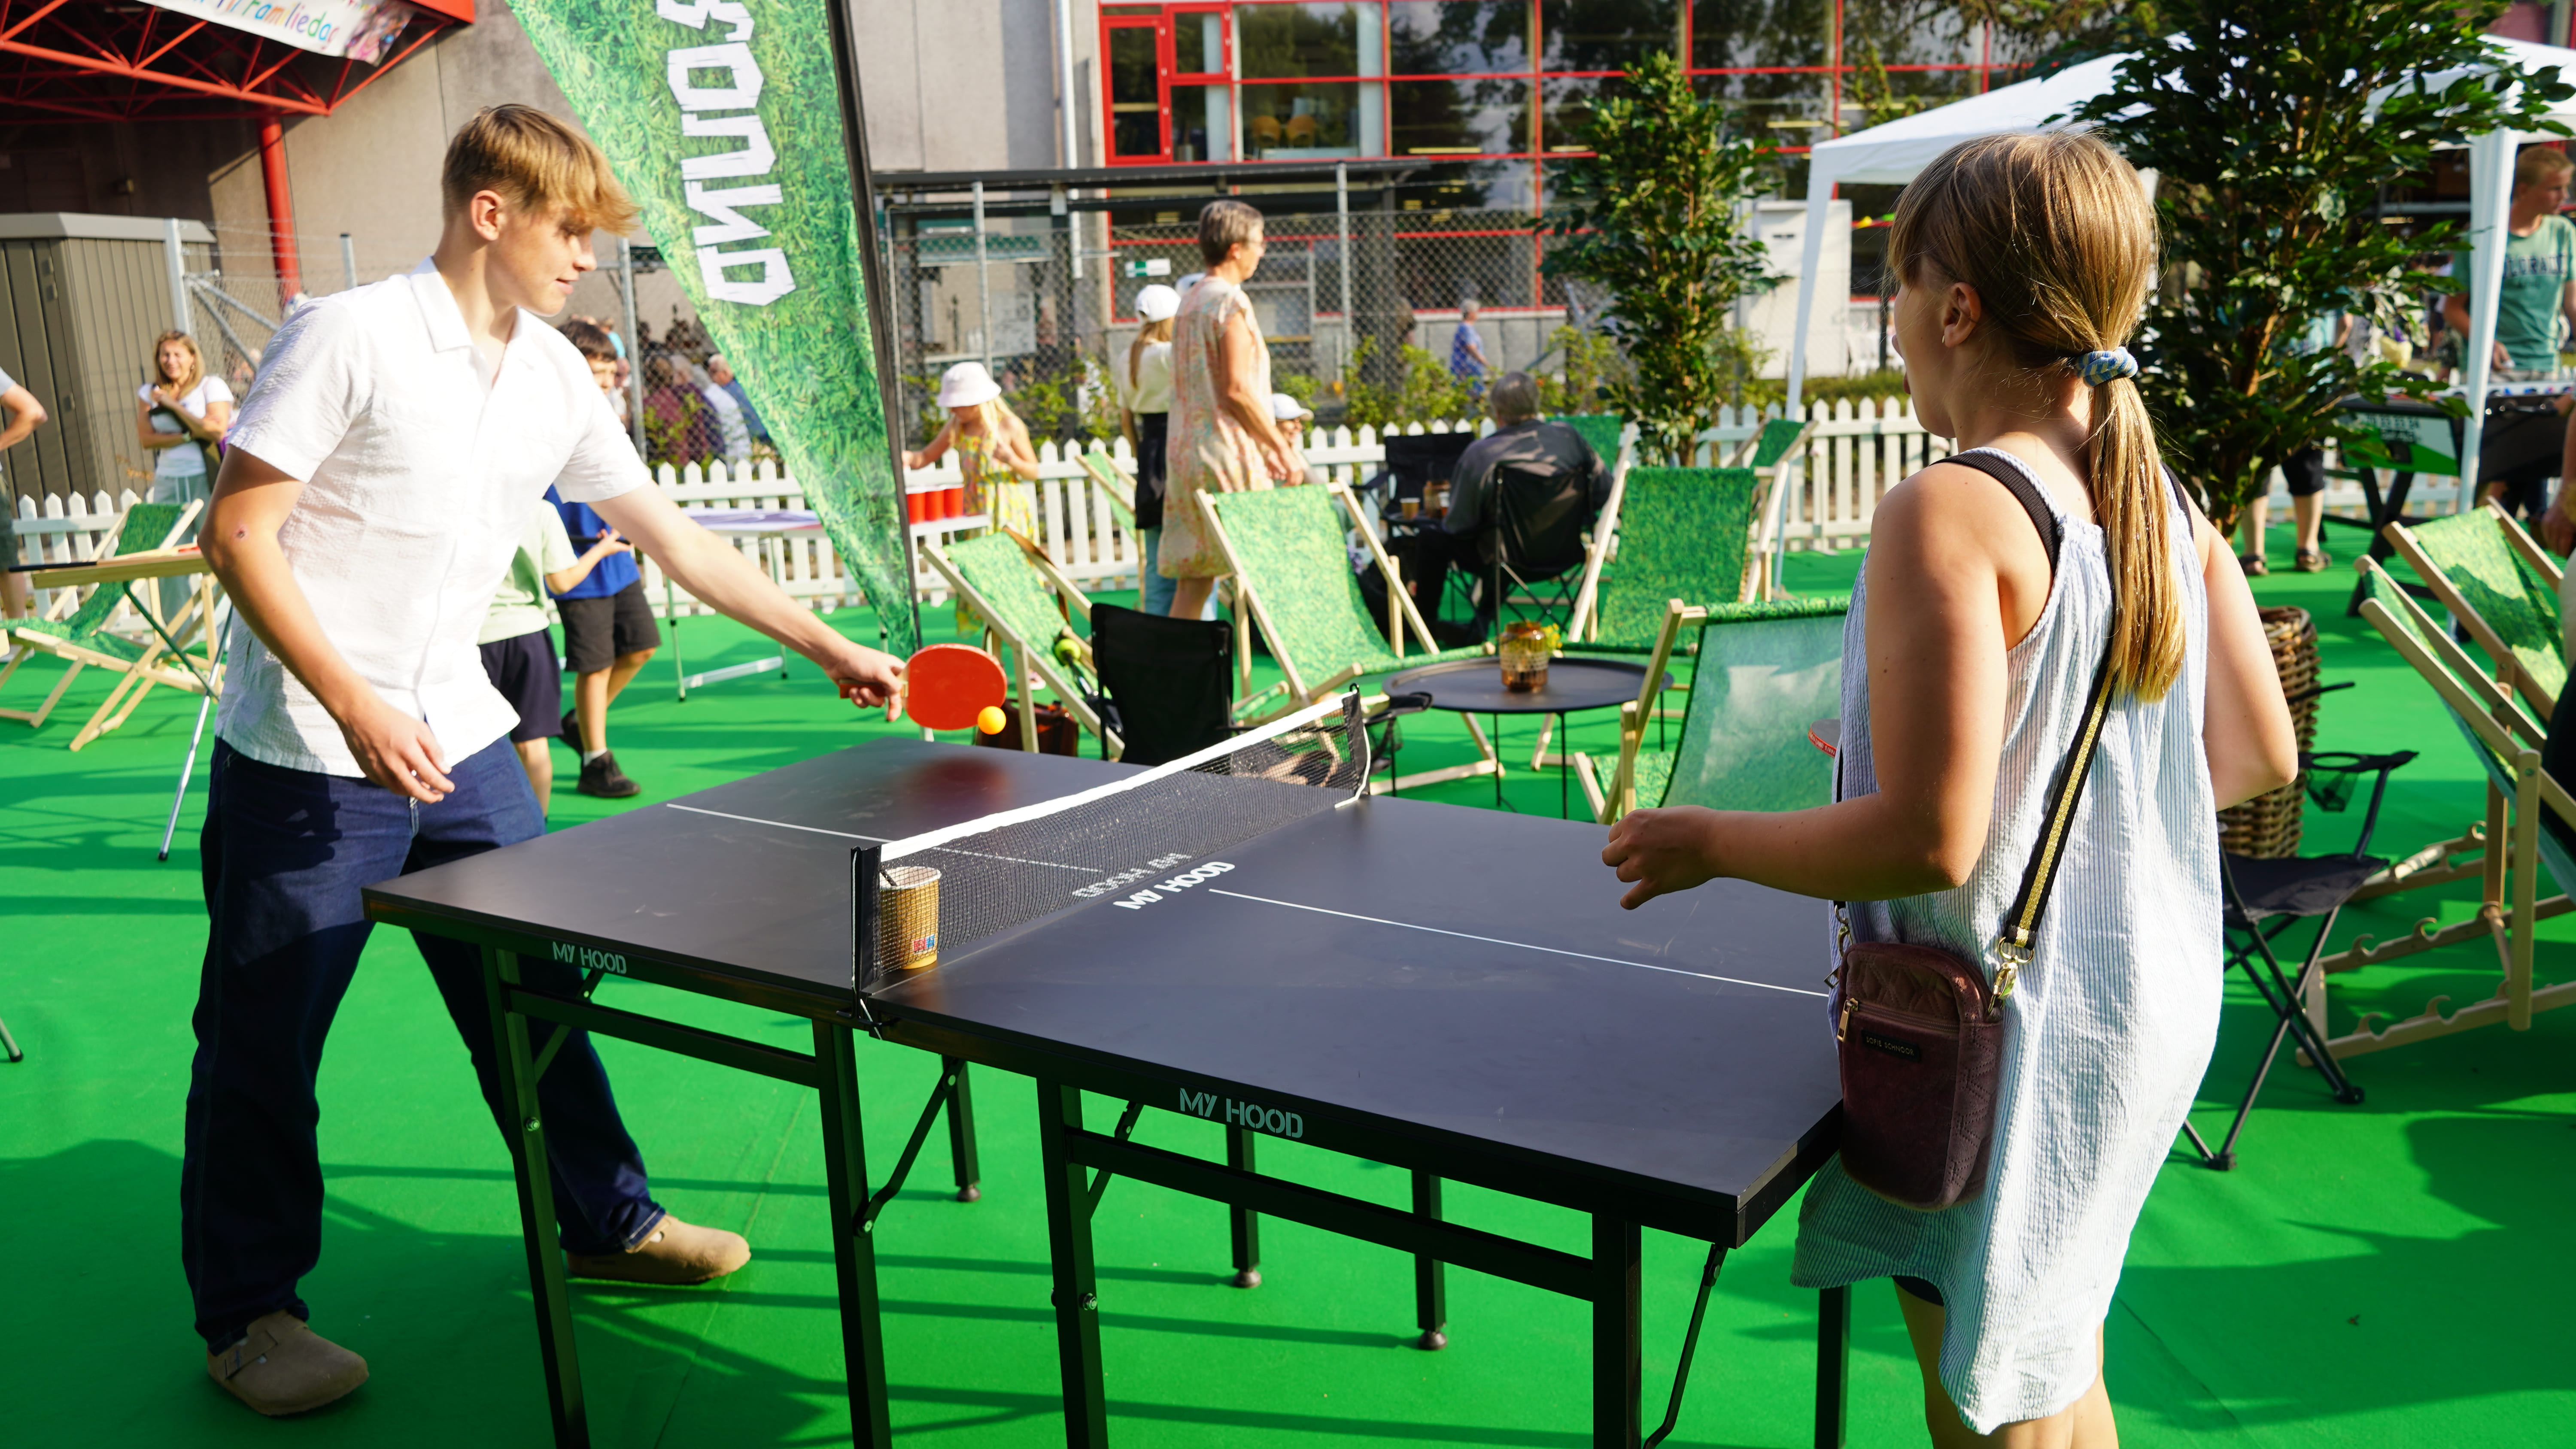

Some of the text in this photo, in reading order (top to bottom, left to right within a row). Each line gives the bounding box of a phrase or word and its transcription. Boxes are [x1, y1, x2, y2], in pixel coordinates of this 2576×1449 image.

[1113, 861, 1235, 909] MY HOOD
[553, 941, 627, 974] MY HOOD
[1866, 1036, 1914, 1056] SOFIE SCHNOOR
[1180, 1088, 1303, 1138] MY HOOD
